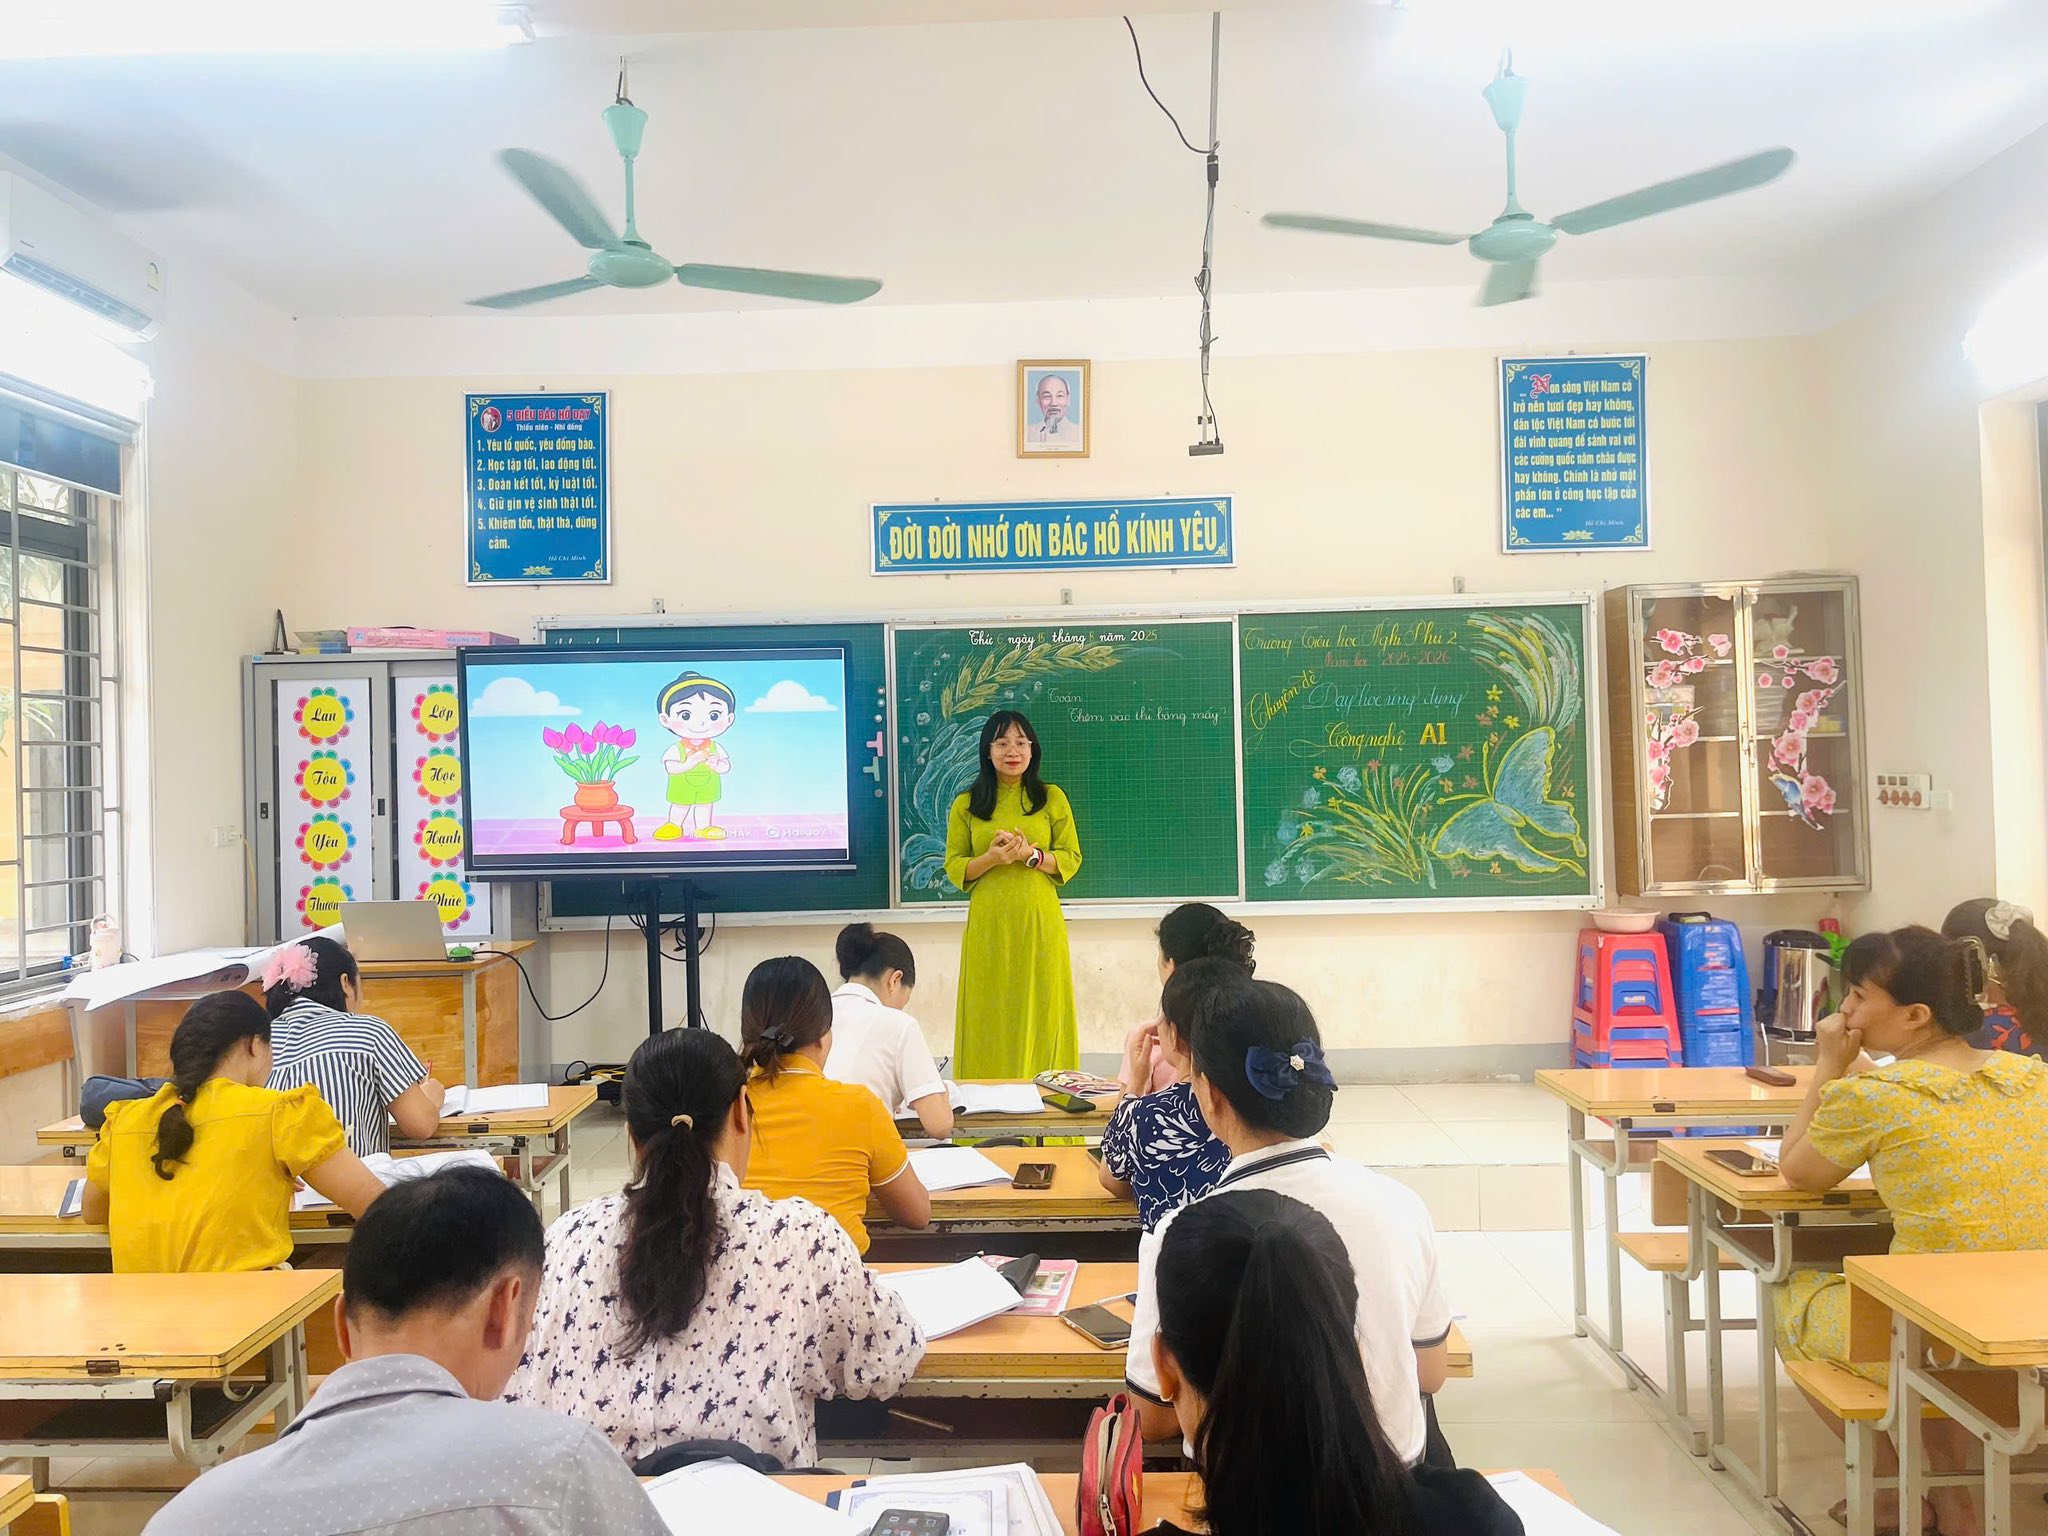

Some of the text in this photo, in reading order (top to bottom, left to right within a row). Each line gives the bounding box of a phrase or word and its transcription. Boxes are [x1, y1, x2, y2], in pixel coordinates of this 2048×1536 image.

[1562, 380, 1581, 394] sông
[1584, 380, 1599, 395] Việt
[1601, 380, 1620, 392] Nam
[1622, 379, 1632, 392] có
[1528, 400, 1544, 412] nên
[1547, 400, 1564, 412] tươi
[1566, 400, 1584, 414] đẹp
[1586, 398, 1602, 412] hay
[507, 410, 513, 422] 5
[538, 407, 556, 420] BÁC
[572, 408, 590, 422] DẠY
[1514, 414, 1635, 432] dân tộc Việt Nam có bước tới
[476, 440, 484, 452] 1.
[486, 438, 502, 451] Yêu
[514, 436, 537, 452] quốc,
[539, 438, 554, 452] yêu
[556, 436, 576, 452] đồng
[1528, 436, 1546, 448] vinh
[1548, 436, 1572, 448] quang
[1575, 432, 1586, 446] để
[1587, 434, 1606, 446] sánh
[1608, 434, 1621, 446] vai
[1623, 433, 1636, 446] với
[476, 455, 596, 473] 2. Học tập tốt, lao động tốt.
[1514, 453, 1528, 466] các
[1556, 450, 1575, 466] quốc
[1577, 452, 1594, 464] năm
[1596, 452, 1615, 464] châu
[1617, 451, 1636, 466] được
[477, 479, 486, 490] 3.
[488, 478, 511, 490] Đoàn
[514, 476, 528, 490] kết
[531, 475, 546, 490] tốt,
[562, 476, 580, 492] luật
[582, 474, 598, 489] tốt.
[1514, 471, 1530, 484] hay
[1564, 470, 1588, 483] Chính
[1590, 469, 1598, 482] là
[1620, 468, 1636, 484] một
[1515, 486, 1536, 502] phần
[1538, 488, 1552, 500] lớn
[1562, 488, 1584, 502] công
[1586, 488, 1602, 502] học
[1604, 486, 1618, 502] tập
[1620, 484, 1636, 500] của
[478, 499, 486, 510] 4.
[489, 496, 504, 510] Giữ
[524, 496, 535, 512] vệ
[538, 497, 558, 509] sinh
[560, 496, 579, 511] thật
[582, 494, 597, 509] tốt.
[1516, 506, 1530, 518] các
[478, 518, 486, 530] 5.
[488, 516, 516, 530] Khiêm
[518, 515, 535, 530] tốn,
[538, 516, 554, 532] thật
[576, 516, 597, 530] dũng
[889, 508, 1218, 560] ĐỜI ĐỜI NHỚ ƠN BÁC HỒ KÍNH YÊU
[488, 536, 510, 550] cảm.
[1008, 632, 1036, 650] ngày
[1052, 629, 1086, 648] tháng
[1100, 632, 1126, 642] năm
[1130, 630, 1158, 642] 2025
[1447, 630, 1457, 644] 2
[1307, 682, 1355, 719] Dạy
[1358, 682, 1383, 710] học
[1424, 684, 1465, 719] dụng
[311, 707, 336, 722] Lan
[428, 704, 454, 722] Lớp
[1068, 708, 1104, 722] Thêm
[1110, 710, 1131, 722] vào
[1325, 722, 1448, 761] Công nghệ AI
[312, 770, 338, 786] Tỏa
[430, 767, 456, 784] Học
[312, 832, 339, 852] Yêu
[425, 830, 462, 848] Hạnh
[308, 896, 340, 912] Thươn
